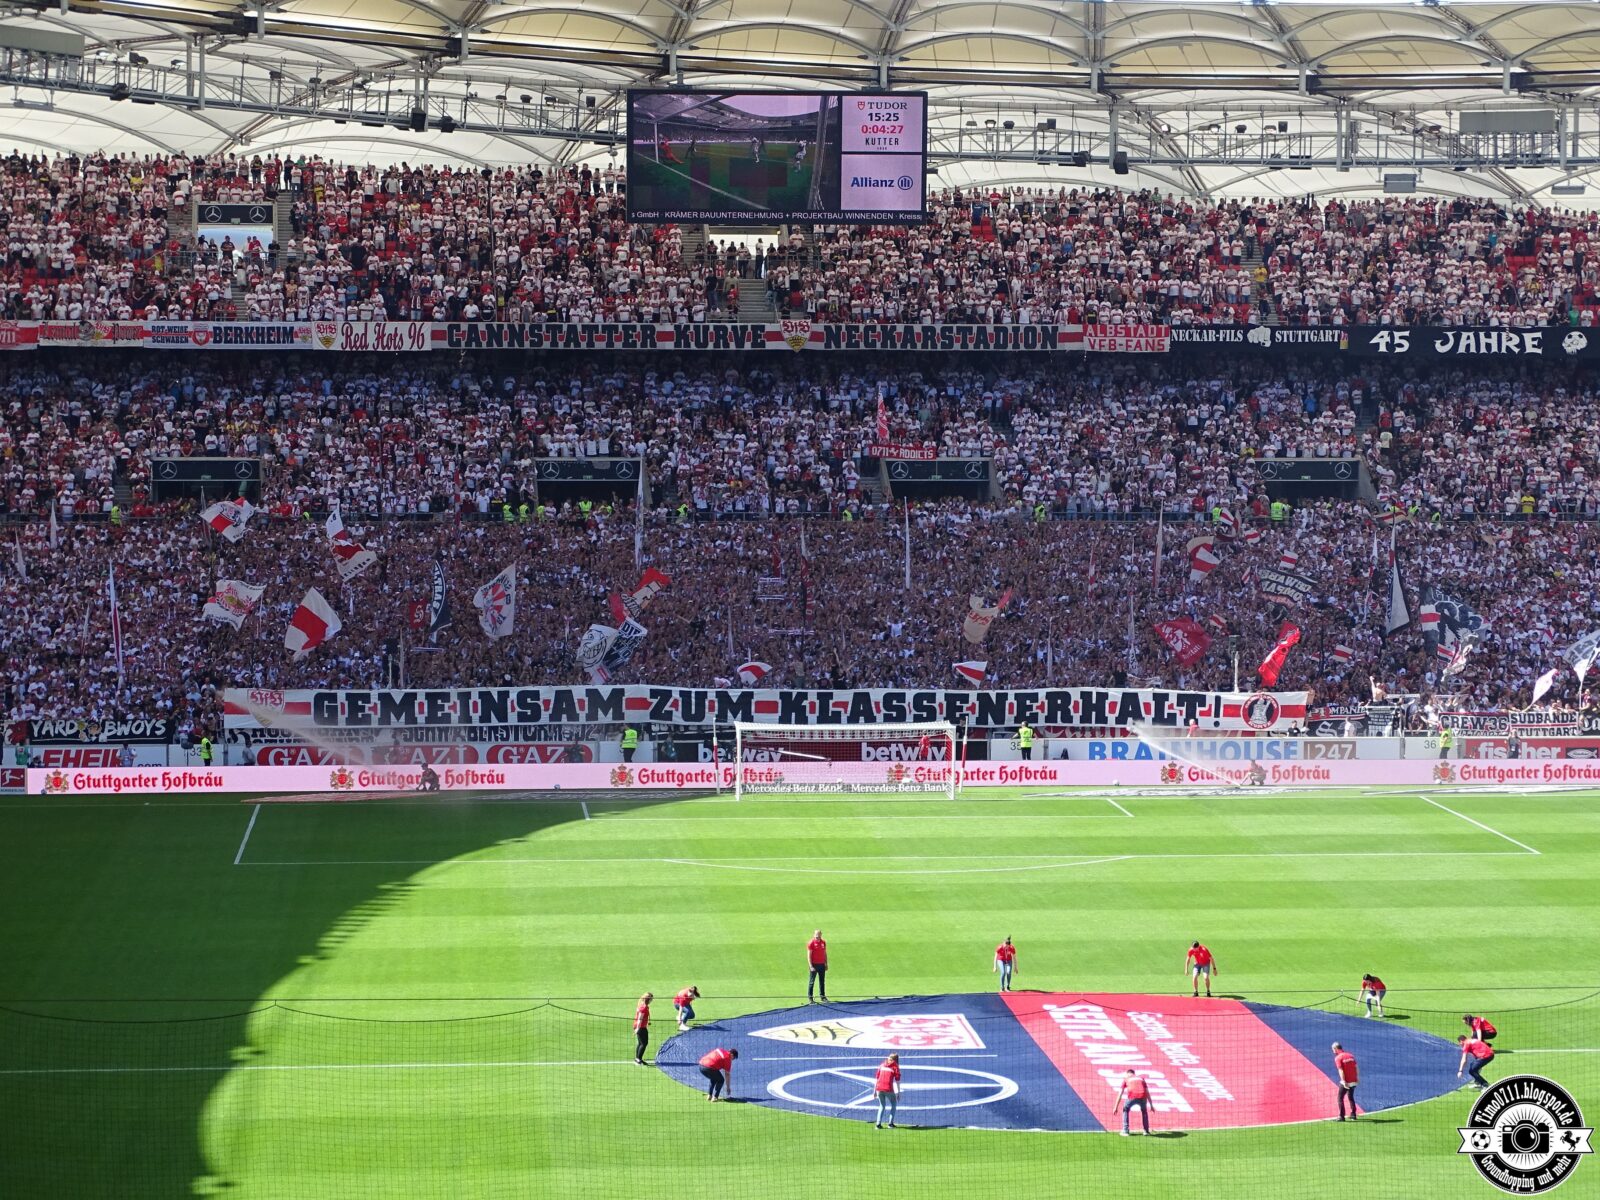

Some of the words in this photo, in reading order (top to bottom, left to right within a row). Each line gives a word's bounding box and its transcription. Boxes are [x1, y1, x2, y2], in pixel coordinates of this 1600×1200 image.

[868, 101, 908, 110] TUDOR
[868, 112, 900, 122] 15:25
[861, 124, 904, 134] 0:04:27
[865, 137, 899, 146] KUTTER
[850, 177, 895, 188] Allianz
[665, 210, 698, 218] KRÄMER
[700, 211, 784, 219] BAUUNTERNEHMUNG
[0, 330, 16, 343] 711
[151, 335, 189, 344] SCHWABEN
[212, 326, 295, 344] BERKHEIM
[341, 322, 369, 351] Red
[372, 322, 404, 351] Hots
[408, 321, 425, 350] 96
[447, 324, 657, 349] CANNSTATTER
[673, 324, 766, 349] KURVE
[823, 325, 1059, 350] NECKARSTADION
[1085, 324, 1169, 337] ALBSTADT
[1171, 329, 1244, 343] NECKAR-FILS
[1275, 329, 1341, 344] STUTTGART
[1087, 338, 1167, 351] VFB-FANS
[1369, 330, 1410, 353] 45
[1434, 330, 1543, 354] JAHRE
[871, 446, 889, 457] 0711
[899, 448, 934, 459] ADDICTS
[313, 687, 626, 726] GEMEINSAM
[649, 687, 754, 724] ZUM
[778, 691, 1222, 727] KLASSENERHALT!
[31, 719, 79, 737] YARD
[104, 719, 167, 737] BWOYS
[698, 742, 785, 763] beway
[1314, 743, 1354, 760] 247
[1423, 740, 1437, 750] 36
[1477, 742, 1562, 760] fisher
[497, 746, 565, 764] GAZ
[73, 772, 158, 791] Stuttgarter
[162, 771, 223, 791] Hofbräu
[444, 769, 505, 788] Hofbräu
[999, 765, 1058, 784] Hofbräu
[1271, 764, 1330, 784] Hofbräu
[1460, 764, 1540, 783] Stuttgarter
[1543, 763, 1600, 783] Hofbräu
[745, 784, 817, 793] Mercedes-Benz
[851, 783, 921, 792] Mercedes-Benz
[924, 783, 948, 792] Bank
[1042, 1003, 1128, 1040] SEITE
[1074, 1042, 1152, 1066] AN
